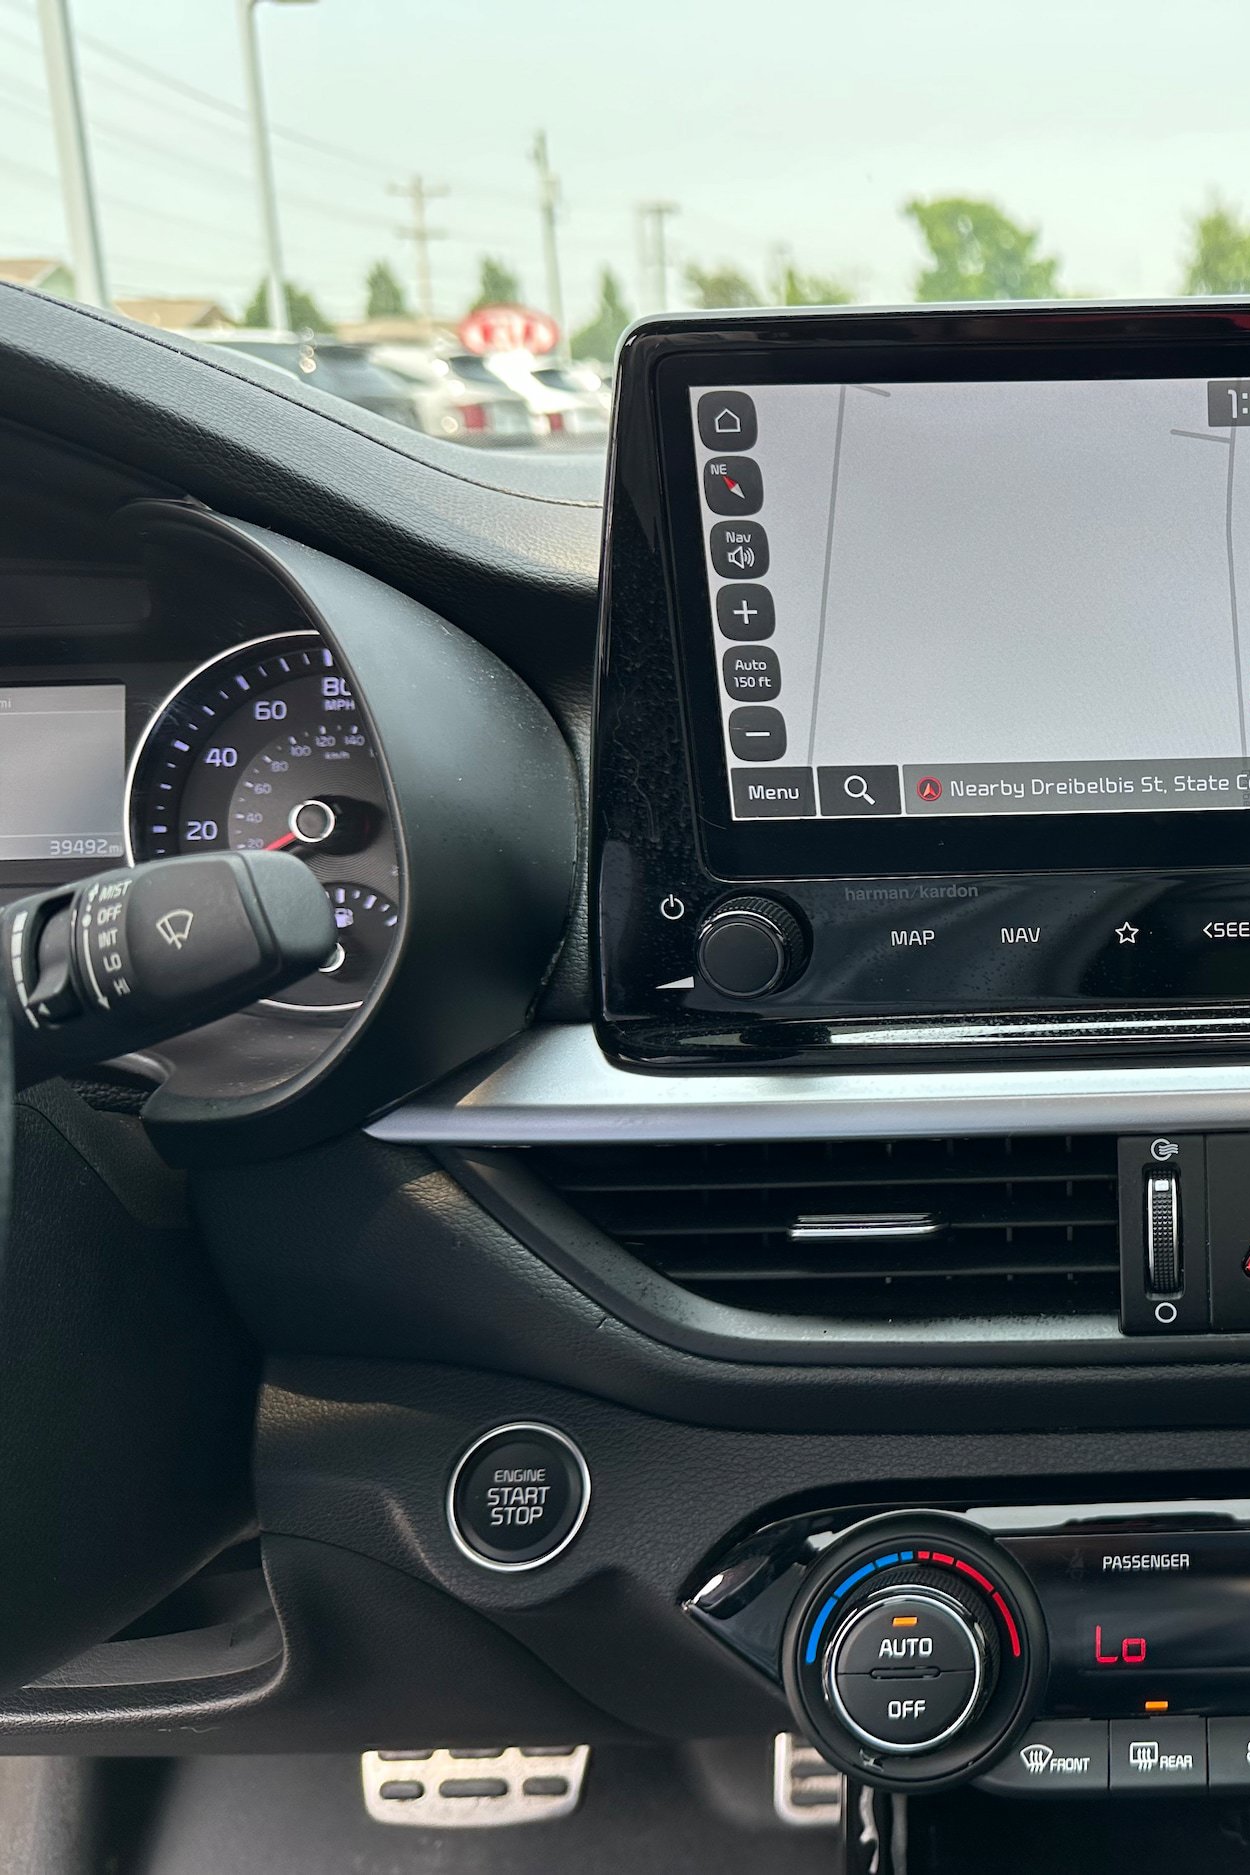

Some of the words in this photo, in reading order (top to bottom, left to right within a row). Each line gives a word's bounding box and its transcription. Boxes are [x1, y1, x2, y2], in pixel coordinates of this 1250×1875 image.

[710, 464, 728, 475] NE
[726, 531, 751, 543] Nav
[735, 659, 767, 671] Auto
[734, 676, 756, 688] 150
[758, 676, 772, 688] ft
[254, 700, 288, 721] 60
[324, 699, 356, 711] MPH
[315, 735, 336, 748] 120
[205, 747, 238, 768] 40
[290, 746, 312, 757] 100
[271, 761, 290, 773] 80
[253, 783, 272, 795] 60
[748, 785, 800, 800] Menu
[950, 780, 1025, 798] Nearby
[1031, 777, 1134, 795] Dreibelbis
[1141, 776, 1168, 794] St,
[1174, 775, 1229, 792] State
[245, 812, 264, 824] 40
[186, 820, 218, 841] 20
[98, 879, 132, 902] MIST
[844, 884, 979, 901] harman/kardon
[97, 903, 123, 924] OFF
[98, 928, 118, 949] INT
[891, 930, 935, 946] MAP
[1001, 927, 1040, 943] NAV
[103, 952, 122, 973] LO
[113, 977, 131, 997] HI
[494, 1468, 546, 1483] ENGINE
[487, 1486, 551, 1506] START
[490, 1506, 543, 1526] STOP
[1102, 1553, 1190, 1571] PASSENGER
[878, 1637, 933, 1659] AUTO
[887, 1699, 926, 1720] OFF
[1050, 1757, 1091, 1773] FRONT
[1159, 1754, 1193, 1770] REAR
